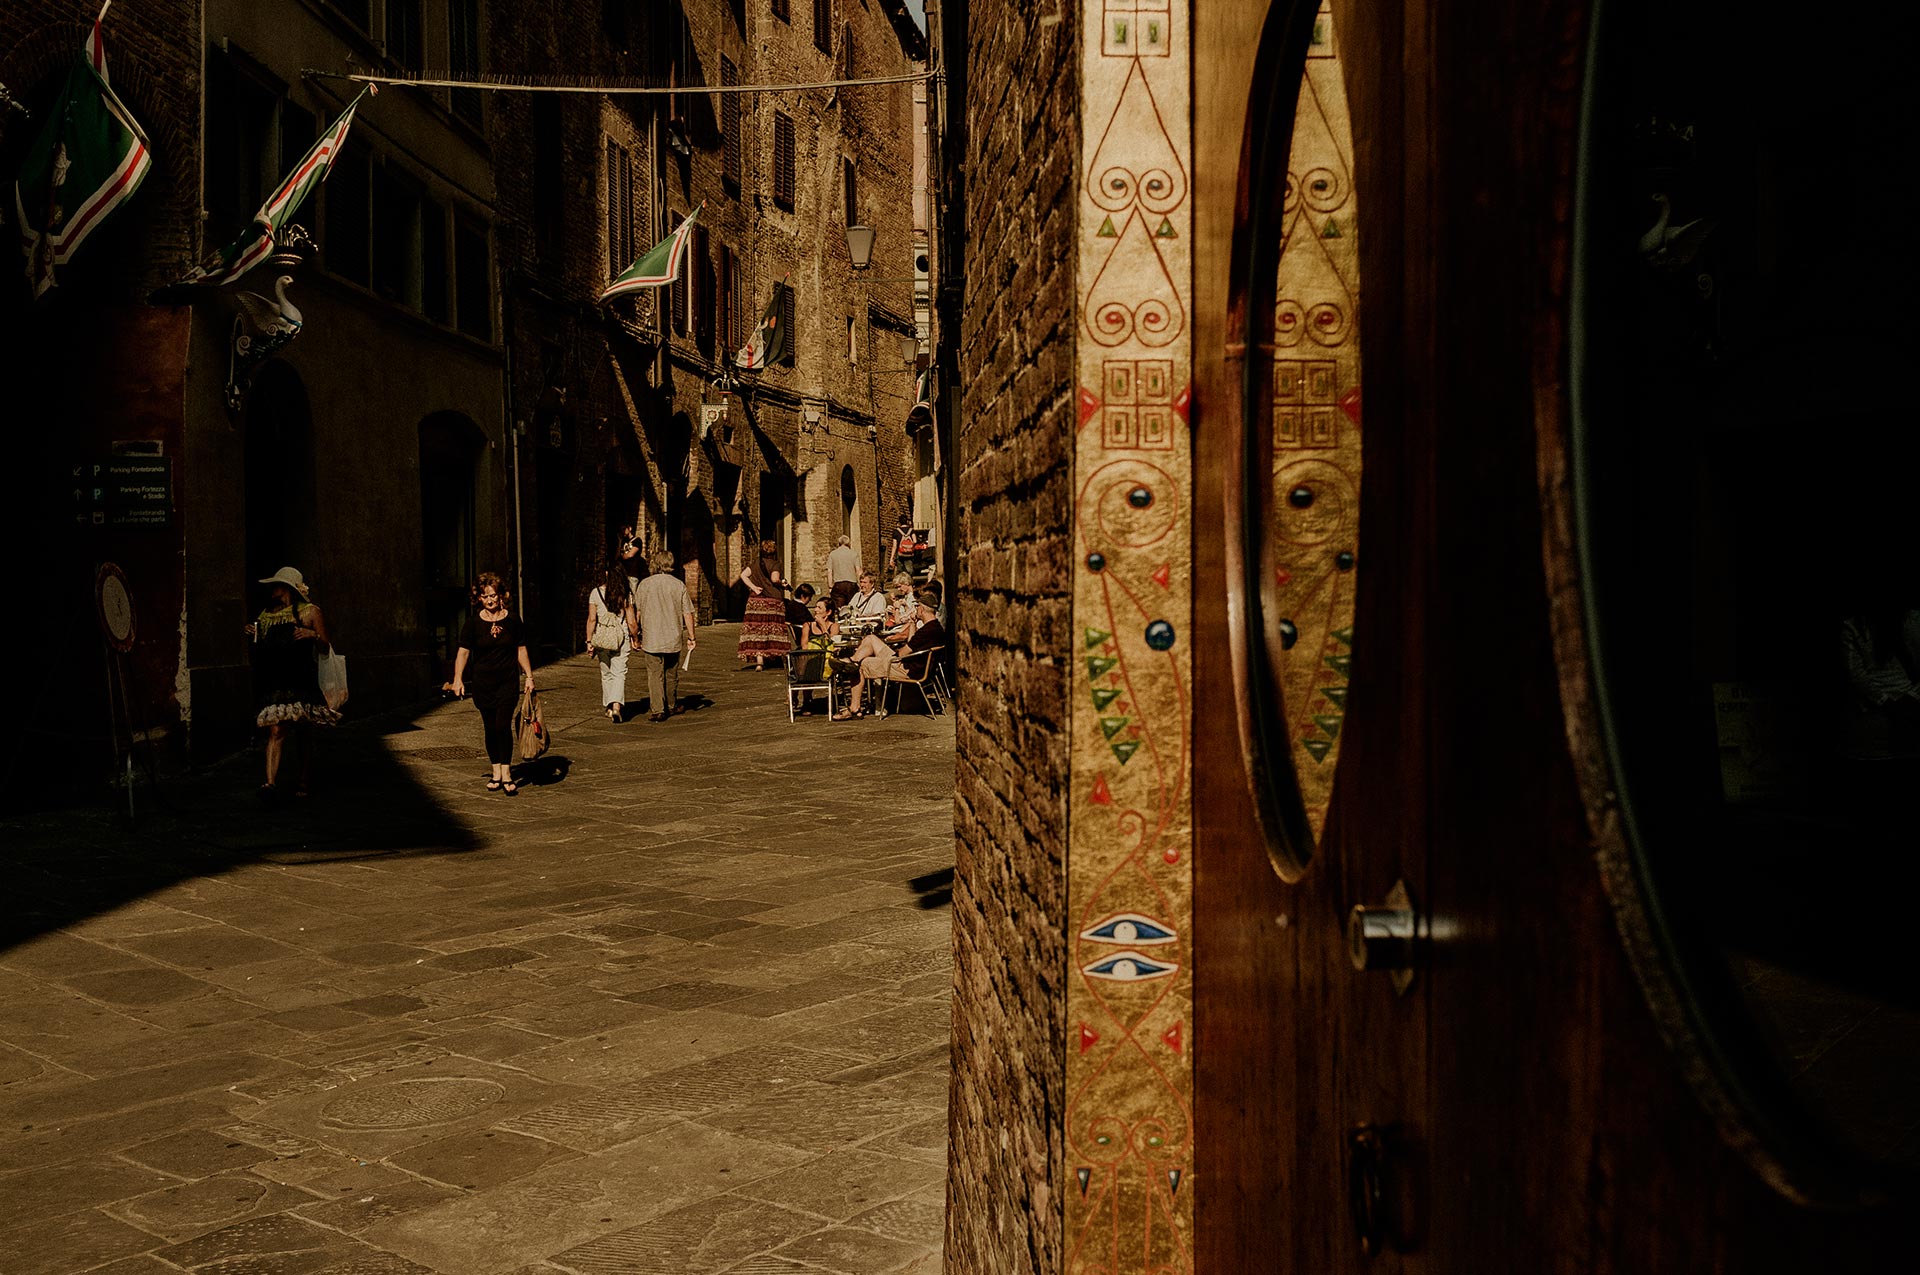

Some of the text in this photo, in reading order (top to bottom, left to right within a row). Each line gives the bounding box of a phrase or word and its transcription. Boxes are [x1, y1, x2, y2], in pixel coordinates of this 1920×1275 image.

[93, 465, 101, 477] P
[110, 466, 131, 474] Parking
[94, 488, 101, 500] P
[120, 486, 141, 494] Parking
